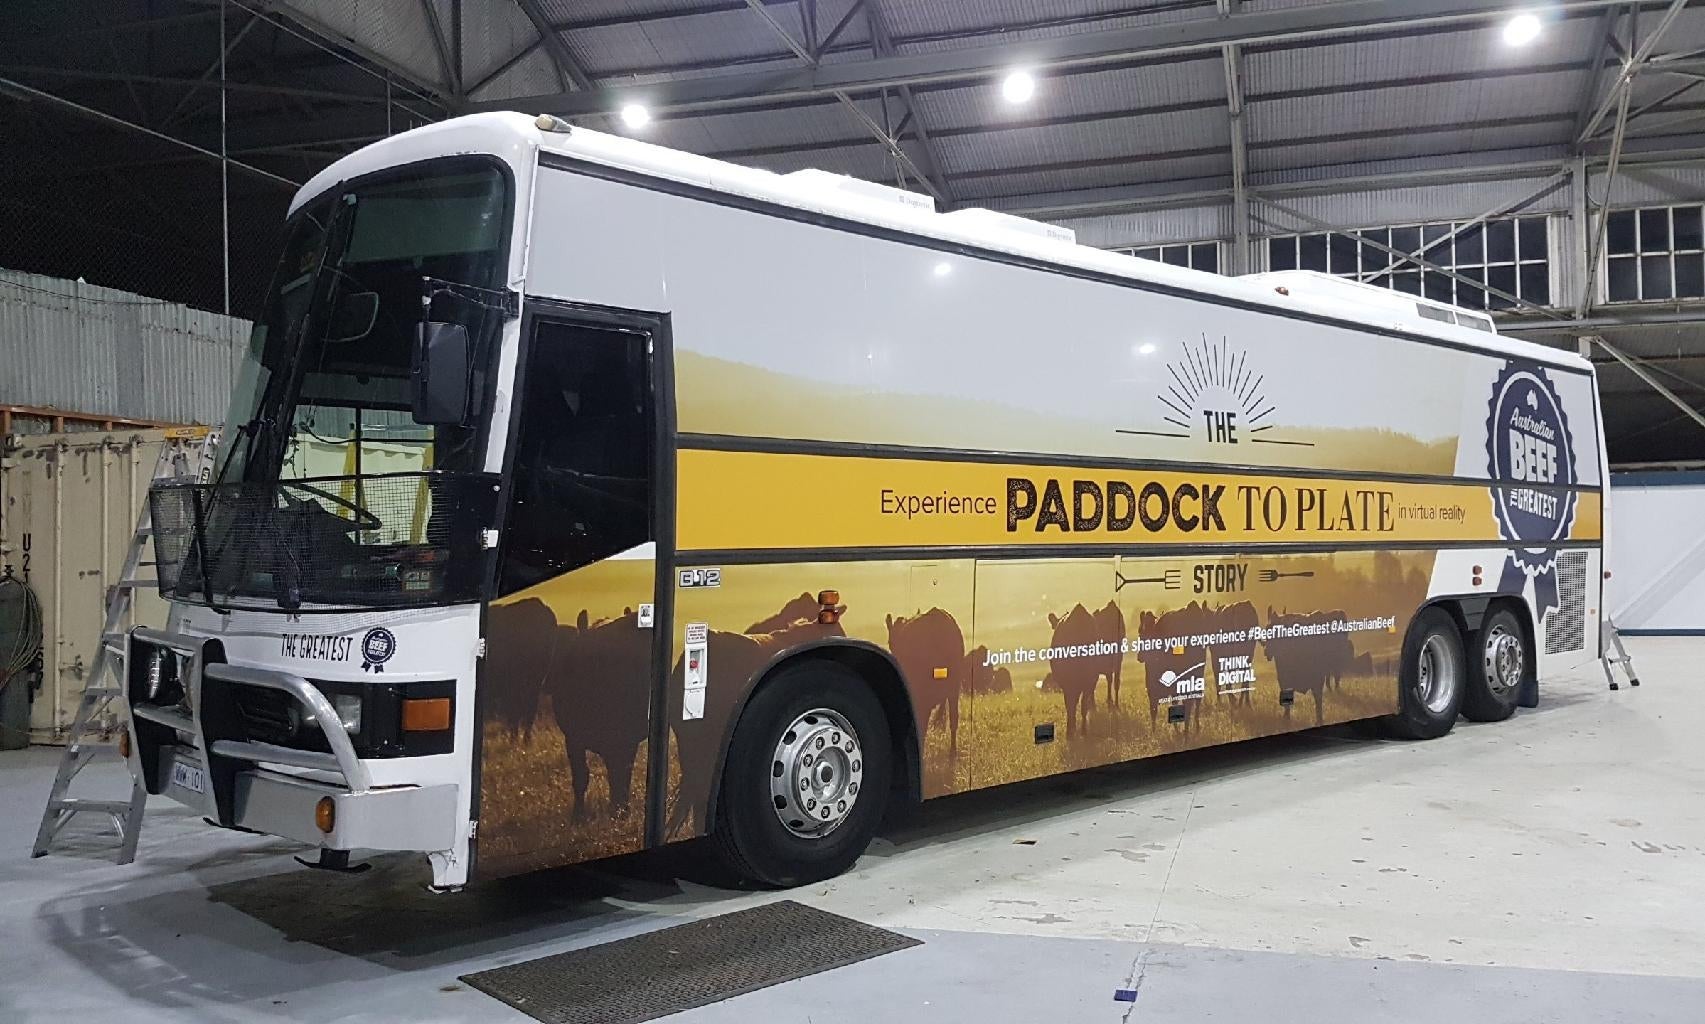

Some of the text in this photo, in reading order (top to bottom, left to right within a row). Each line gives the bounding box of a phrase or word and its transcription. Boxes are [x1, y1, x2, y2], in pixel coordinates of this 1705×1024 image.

[1203, 409, 1238, 444] THE
[1510, 406, 1555, 441] Australian
[1508, 428, 1558, 484] BEEF
[881, 478, 1466, 533] Experience PADDOCK TO PLATE in virtual reality
[1517, 488, 1558, 520] GREATEST
[679, 569, 720, 587] B12
[1193, 563, 1249, 594] STORY
[281, 633, 354, 662] THE GREATEST
[983, 615, 1396, 667] Join the conversation & share your experience #BeefTheGreatest @AustralianBeef
[1218, 655, 1252, 671] THINK.
[1218, 669, 1256, 686] DIGITAL
[1176, 675, 1205, 694] mla
